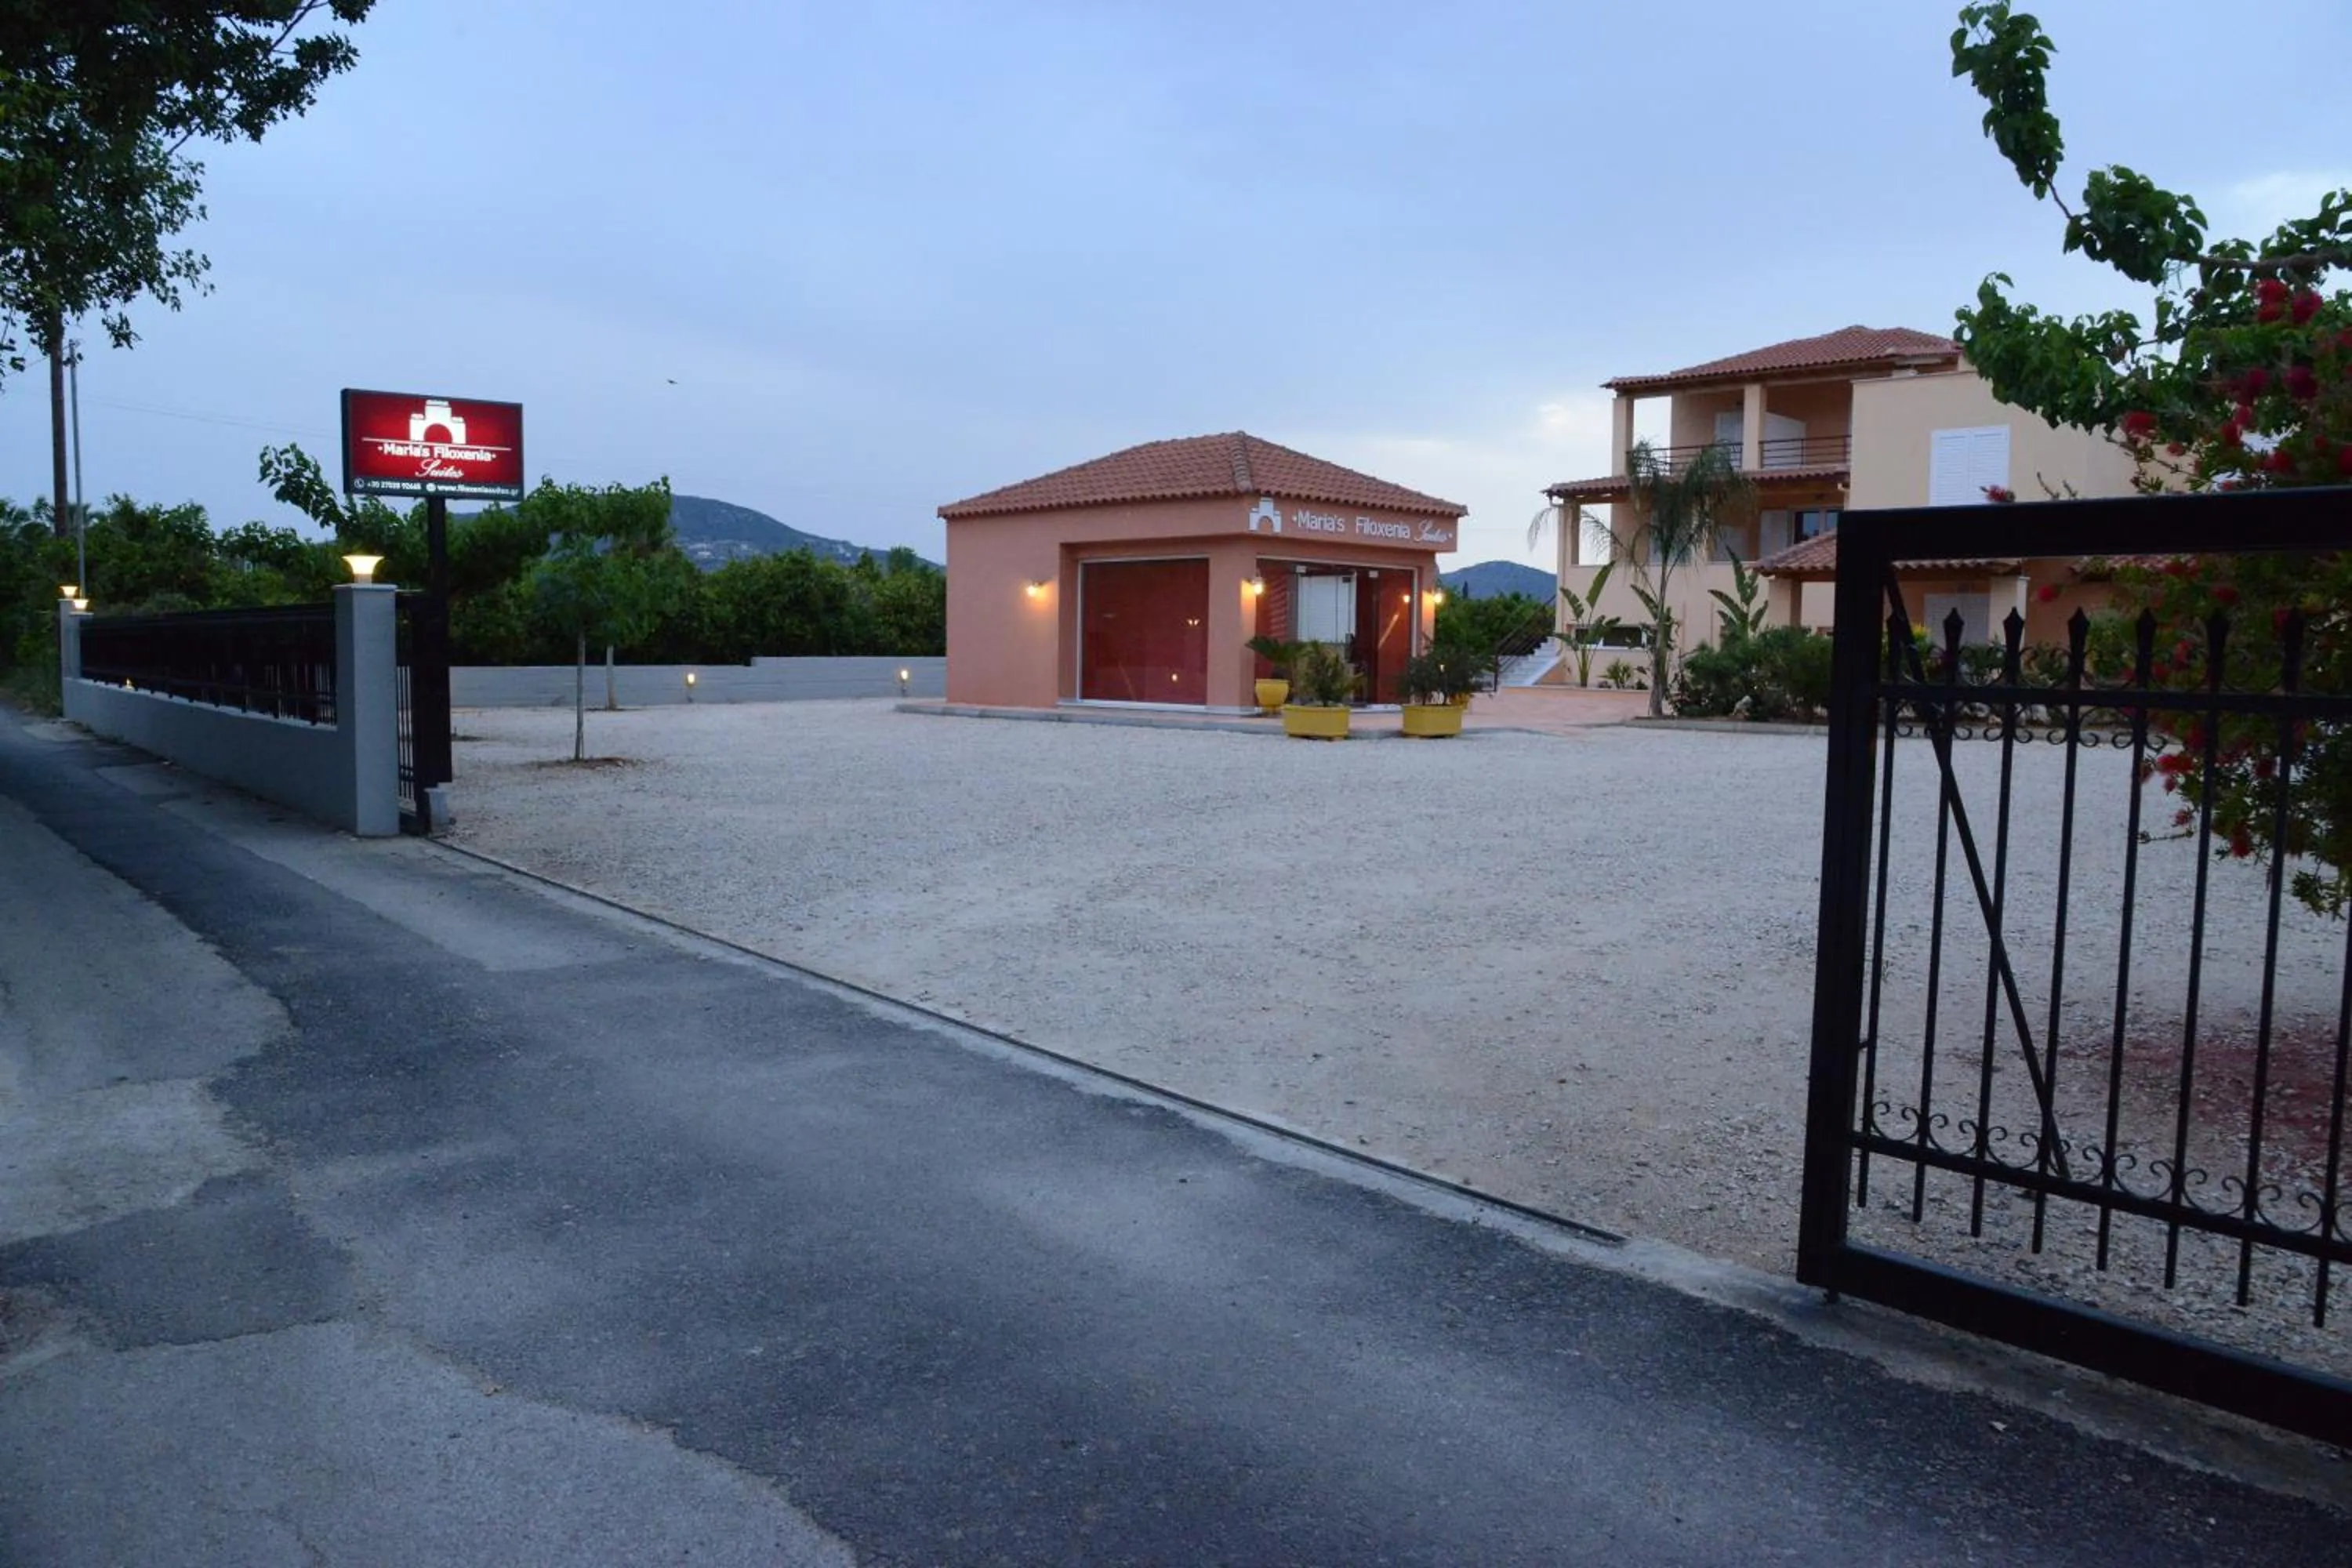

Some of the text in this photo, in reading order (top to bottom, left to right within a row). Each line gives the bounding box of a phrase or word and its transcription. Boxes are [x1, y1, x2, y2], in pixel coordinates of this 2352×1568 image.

[383, 442, 492, 462] Maria's Filoxenia
[415, 459, 465, 478] Suites
[1298, 510, 1345, 532] Maria's
[1356, 516, 1411, 538] Filoxenia
